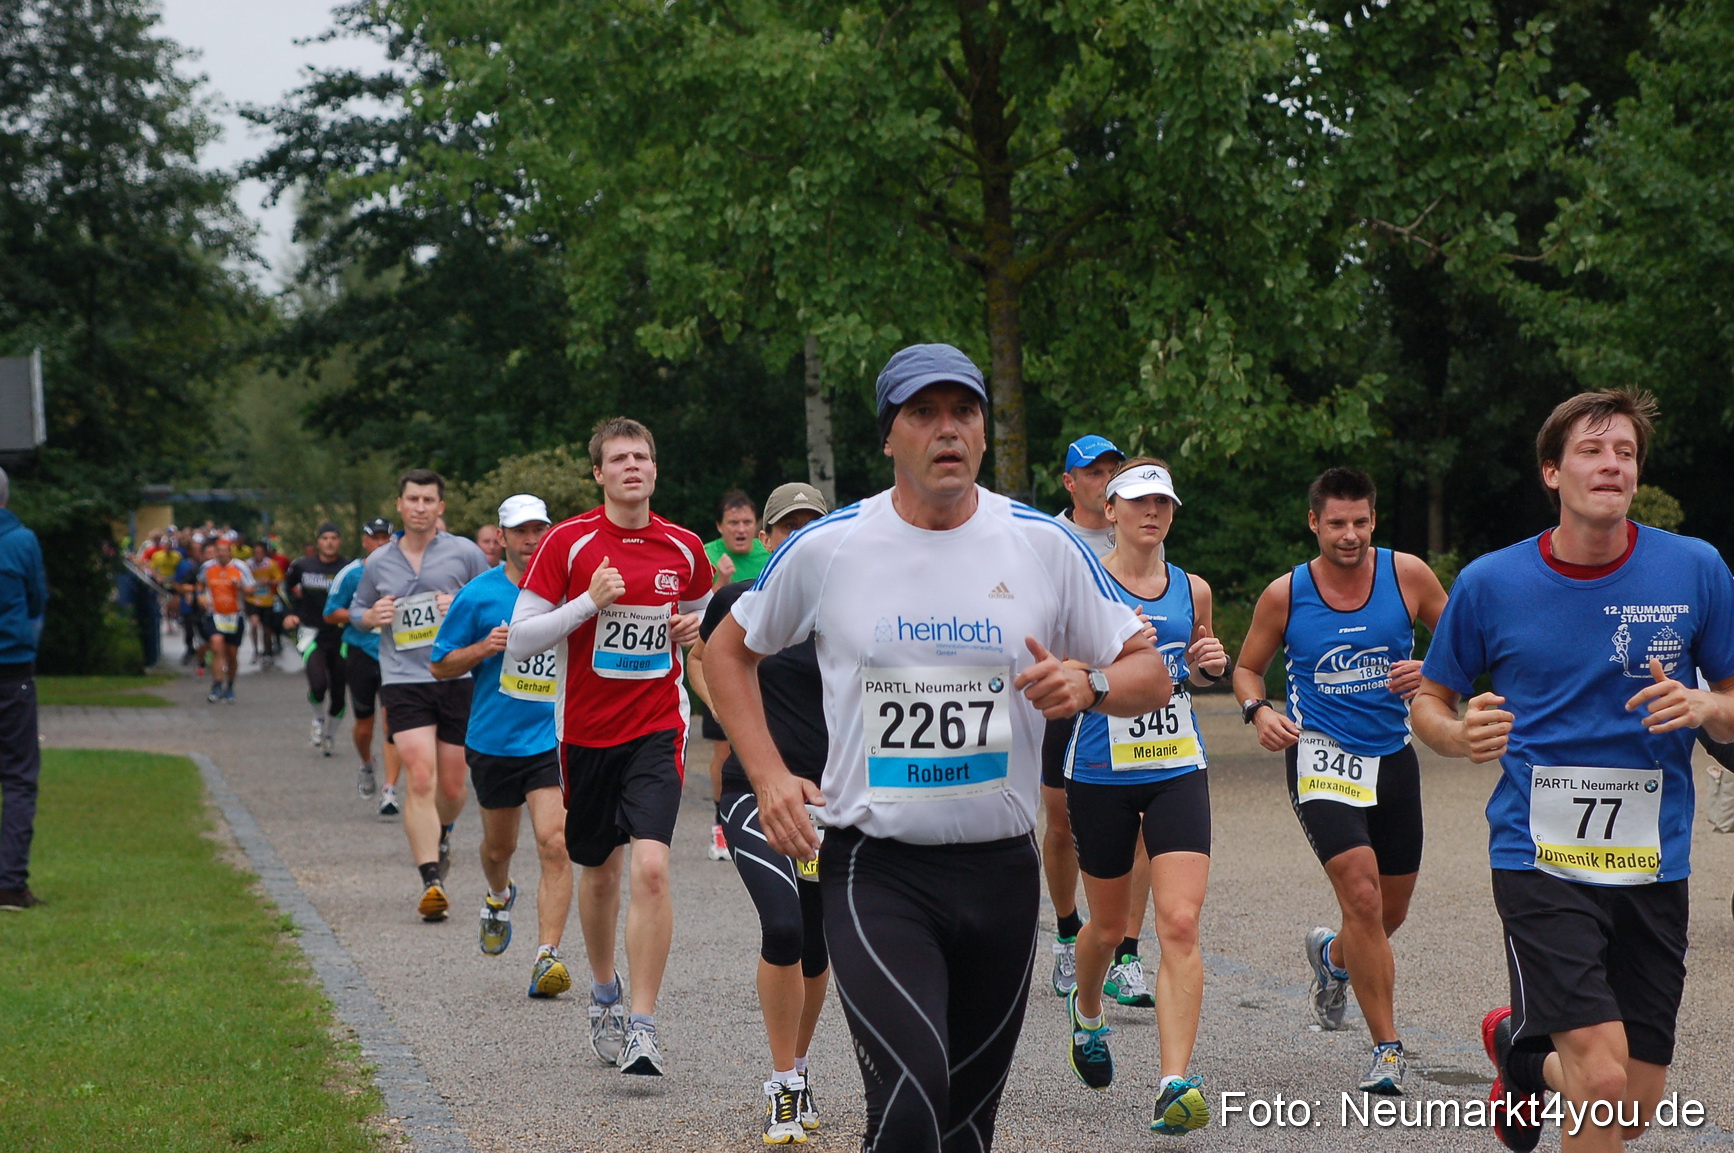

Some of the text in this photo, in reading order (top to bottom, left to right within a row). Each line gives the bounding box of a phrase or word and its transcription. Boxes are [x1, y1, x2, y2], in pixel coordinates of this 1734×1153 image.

[988, 592, 1015, 600] adidas
[402, 606, 435, 628] 424
[600, 609, 664, 621] PARTL Neumarkt
[1603, 605, 1689, 615] 12. NEUMARKTER
[1620, 614, 1677, 623] STADTLAUF
[603, 621, 667, 651] 2648
[897, 615, 1002, 644] heinloth
[517, 653, 556, 678] 382
[615, 657, 651, 671] Jürgen
[1360, 665, 1390, 679] 1860
[516, 680, 551, 692] Gerhard
[865, 681, 982, 694] PARTL Neumarkt
[879, 701, 995, 750] 2267
[1128, 704, 1179, 738] 345
[1300, 737, 1326, 747] PARTL
[1133, 743, 1178, 758] Melanie
[1313, 749, 1363, 781] 346
[907, 763, 970, 783] Robert
[1309, 779, 1361, 798] Alexander
[1534, 777, 1639, 791] PARTL Neumarkt
[1573, 797, 1623, 840] 77
